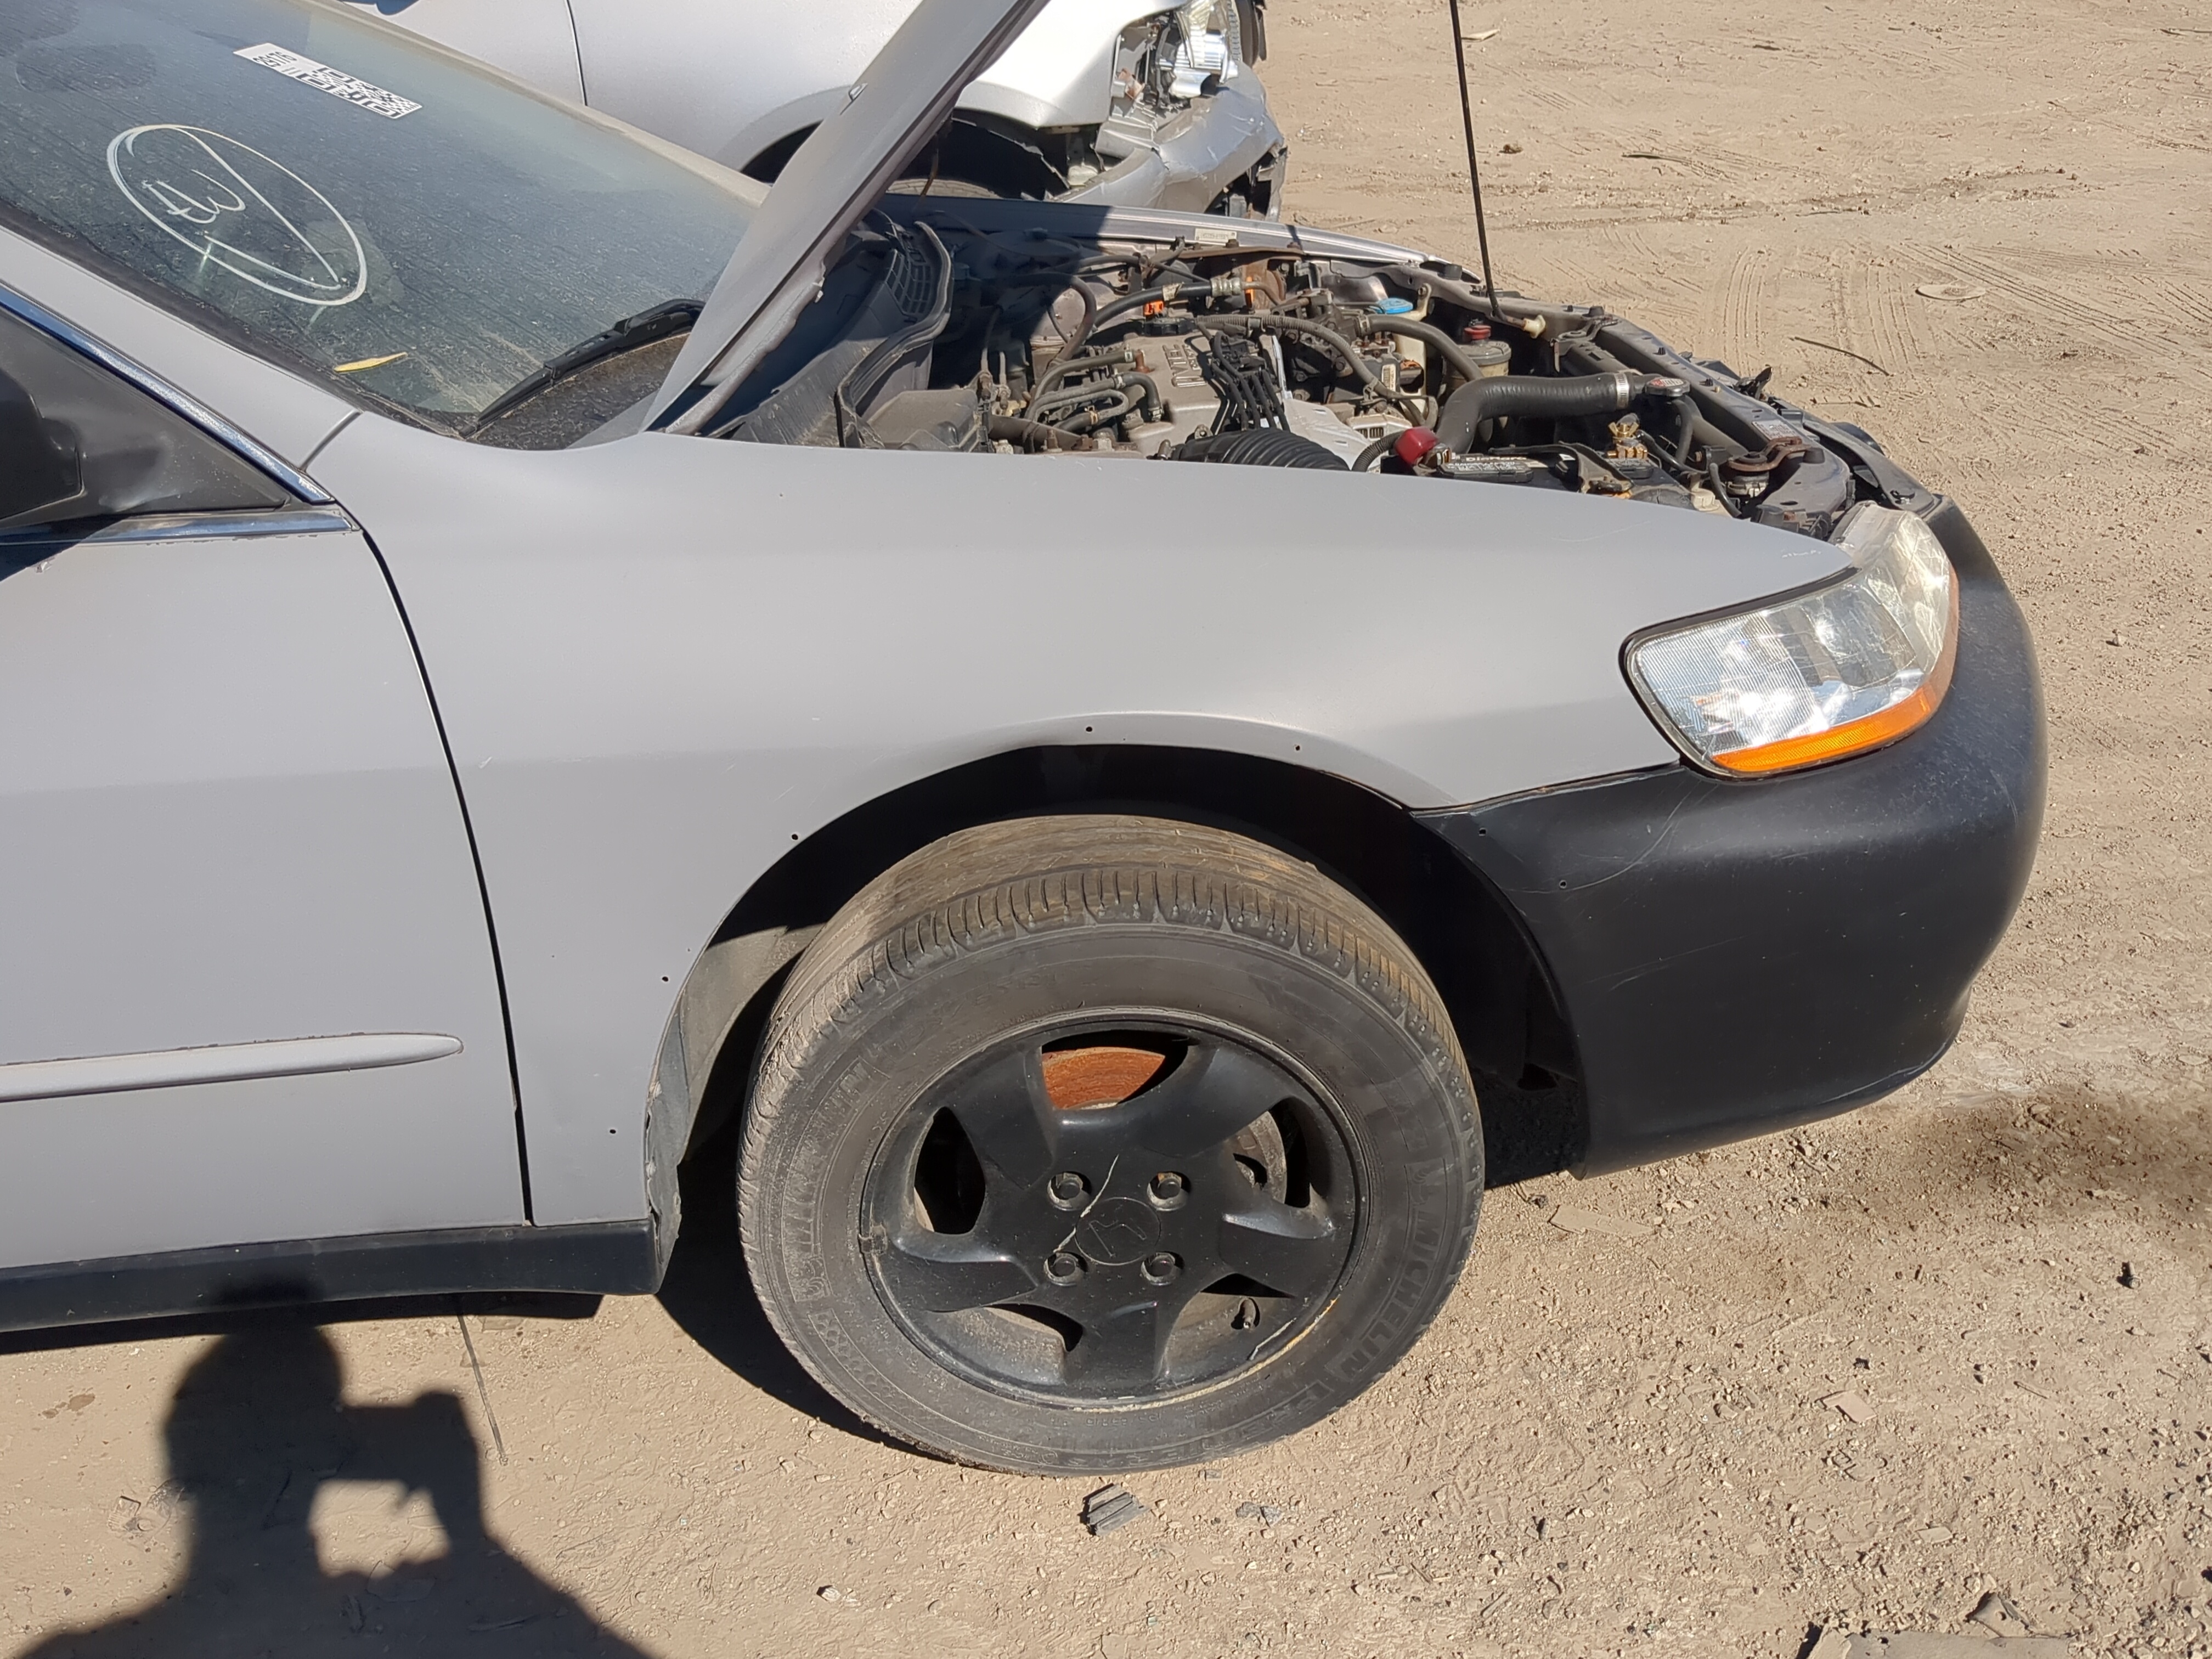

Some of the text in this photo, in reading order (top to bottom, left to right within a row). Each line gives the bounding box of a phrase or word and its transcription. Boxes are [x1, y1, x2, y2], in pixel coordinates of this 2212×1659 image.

[252, 52, 297, 67] 29176
[1162, 345, 1188, 376] VTEC
[1341, 1210, 1441, 1378] MICHELIN
